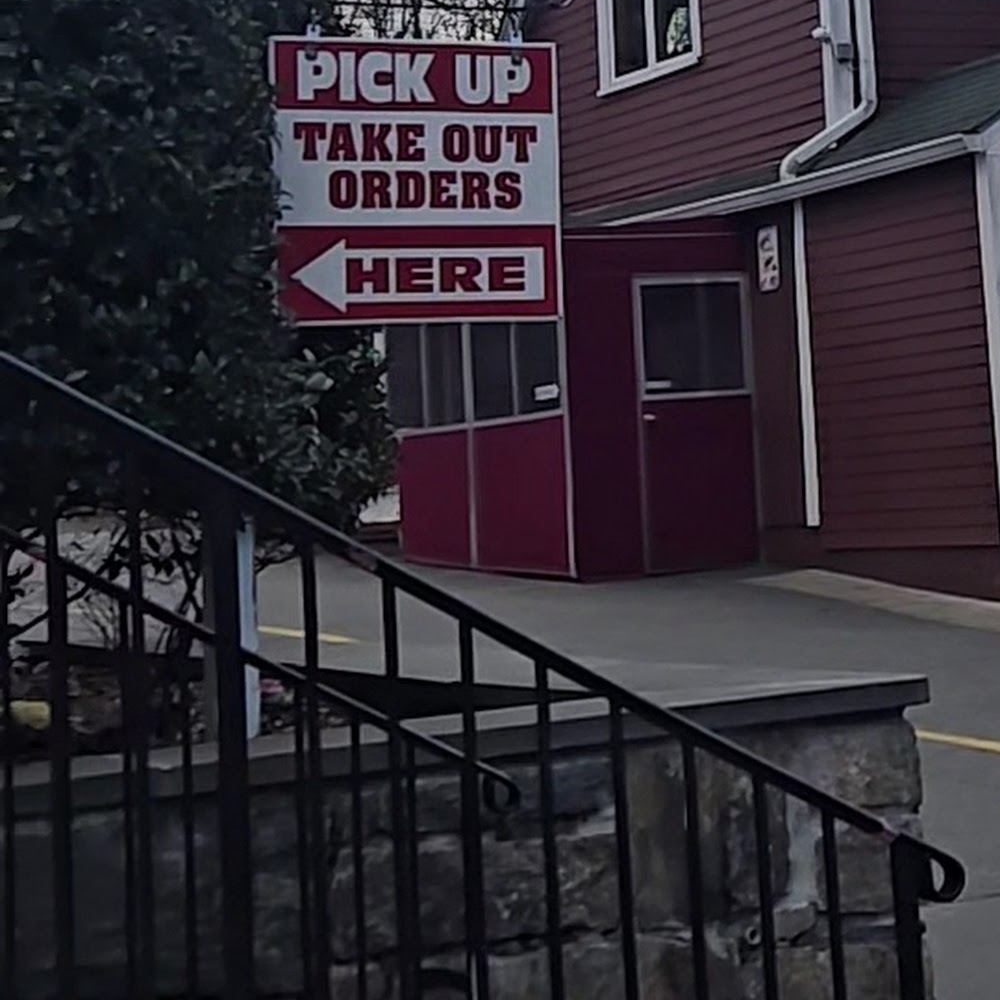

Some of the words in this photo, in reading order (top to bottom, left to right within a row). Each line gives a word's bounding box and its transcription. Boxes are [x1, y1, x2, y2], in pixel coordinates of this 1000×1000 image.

[297, 51, 435, 102] PICK
[455, 53, 531, 104] UP
[293, 122, 425, 161] TAKE
[442, 124, 537, 163] OUT
[328, 170, 522, 209] ORDERS
[346, 256, 525, 293] HERE
